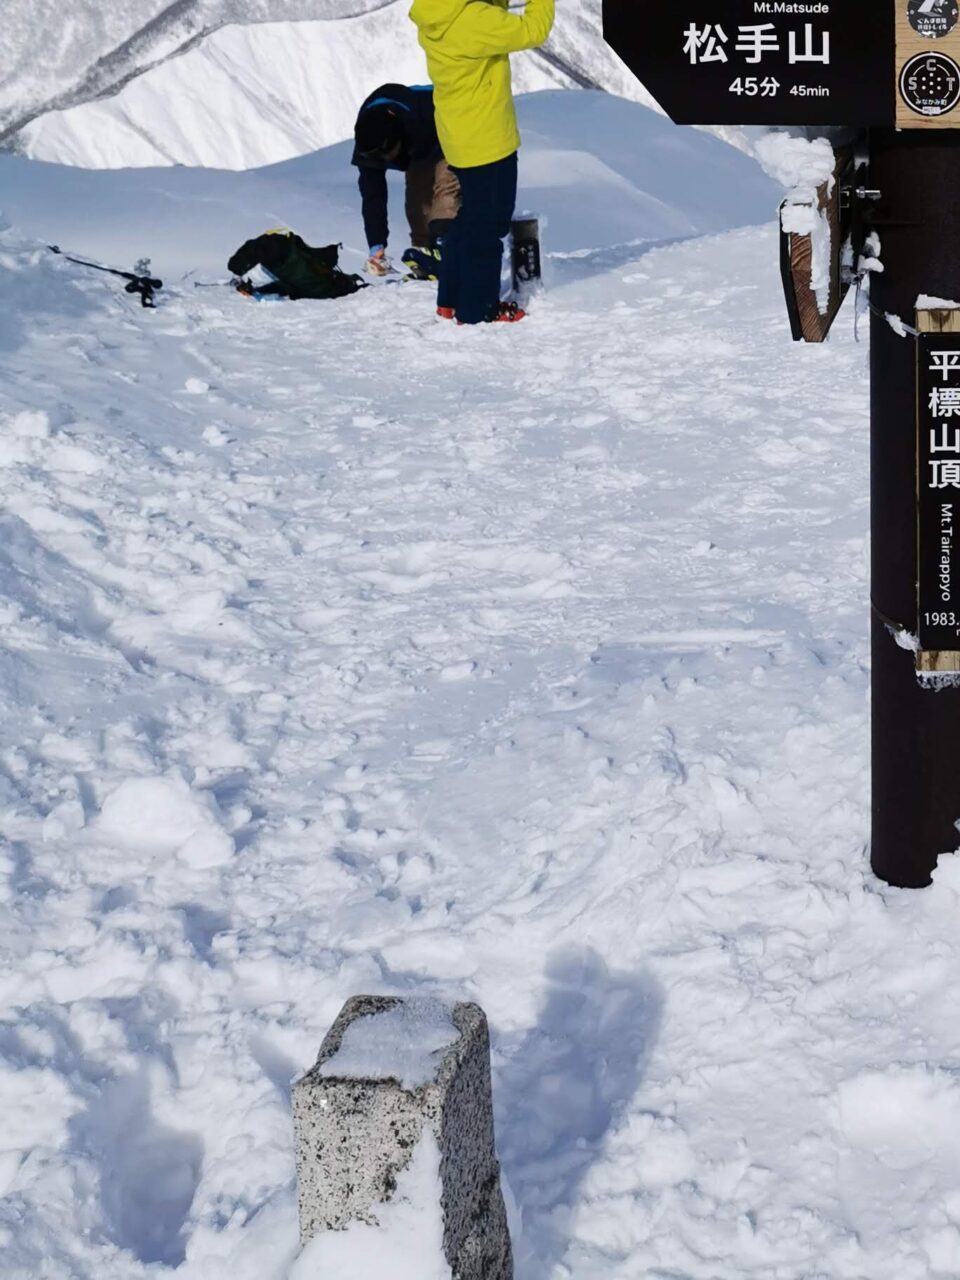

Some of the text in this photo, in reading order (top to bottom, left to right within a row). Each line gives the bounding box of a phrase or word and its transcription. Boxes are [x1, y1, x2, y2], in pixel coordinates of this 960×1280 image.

[753, 1, 829, 14] Mt.Matsude
[682, 22, 830, 65] 松手山
[728, 76, 830, 97] 45分 45min
[939, 503, 953, 602] Mt.Tairappyo
